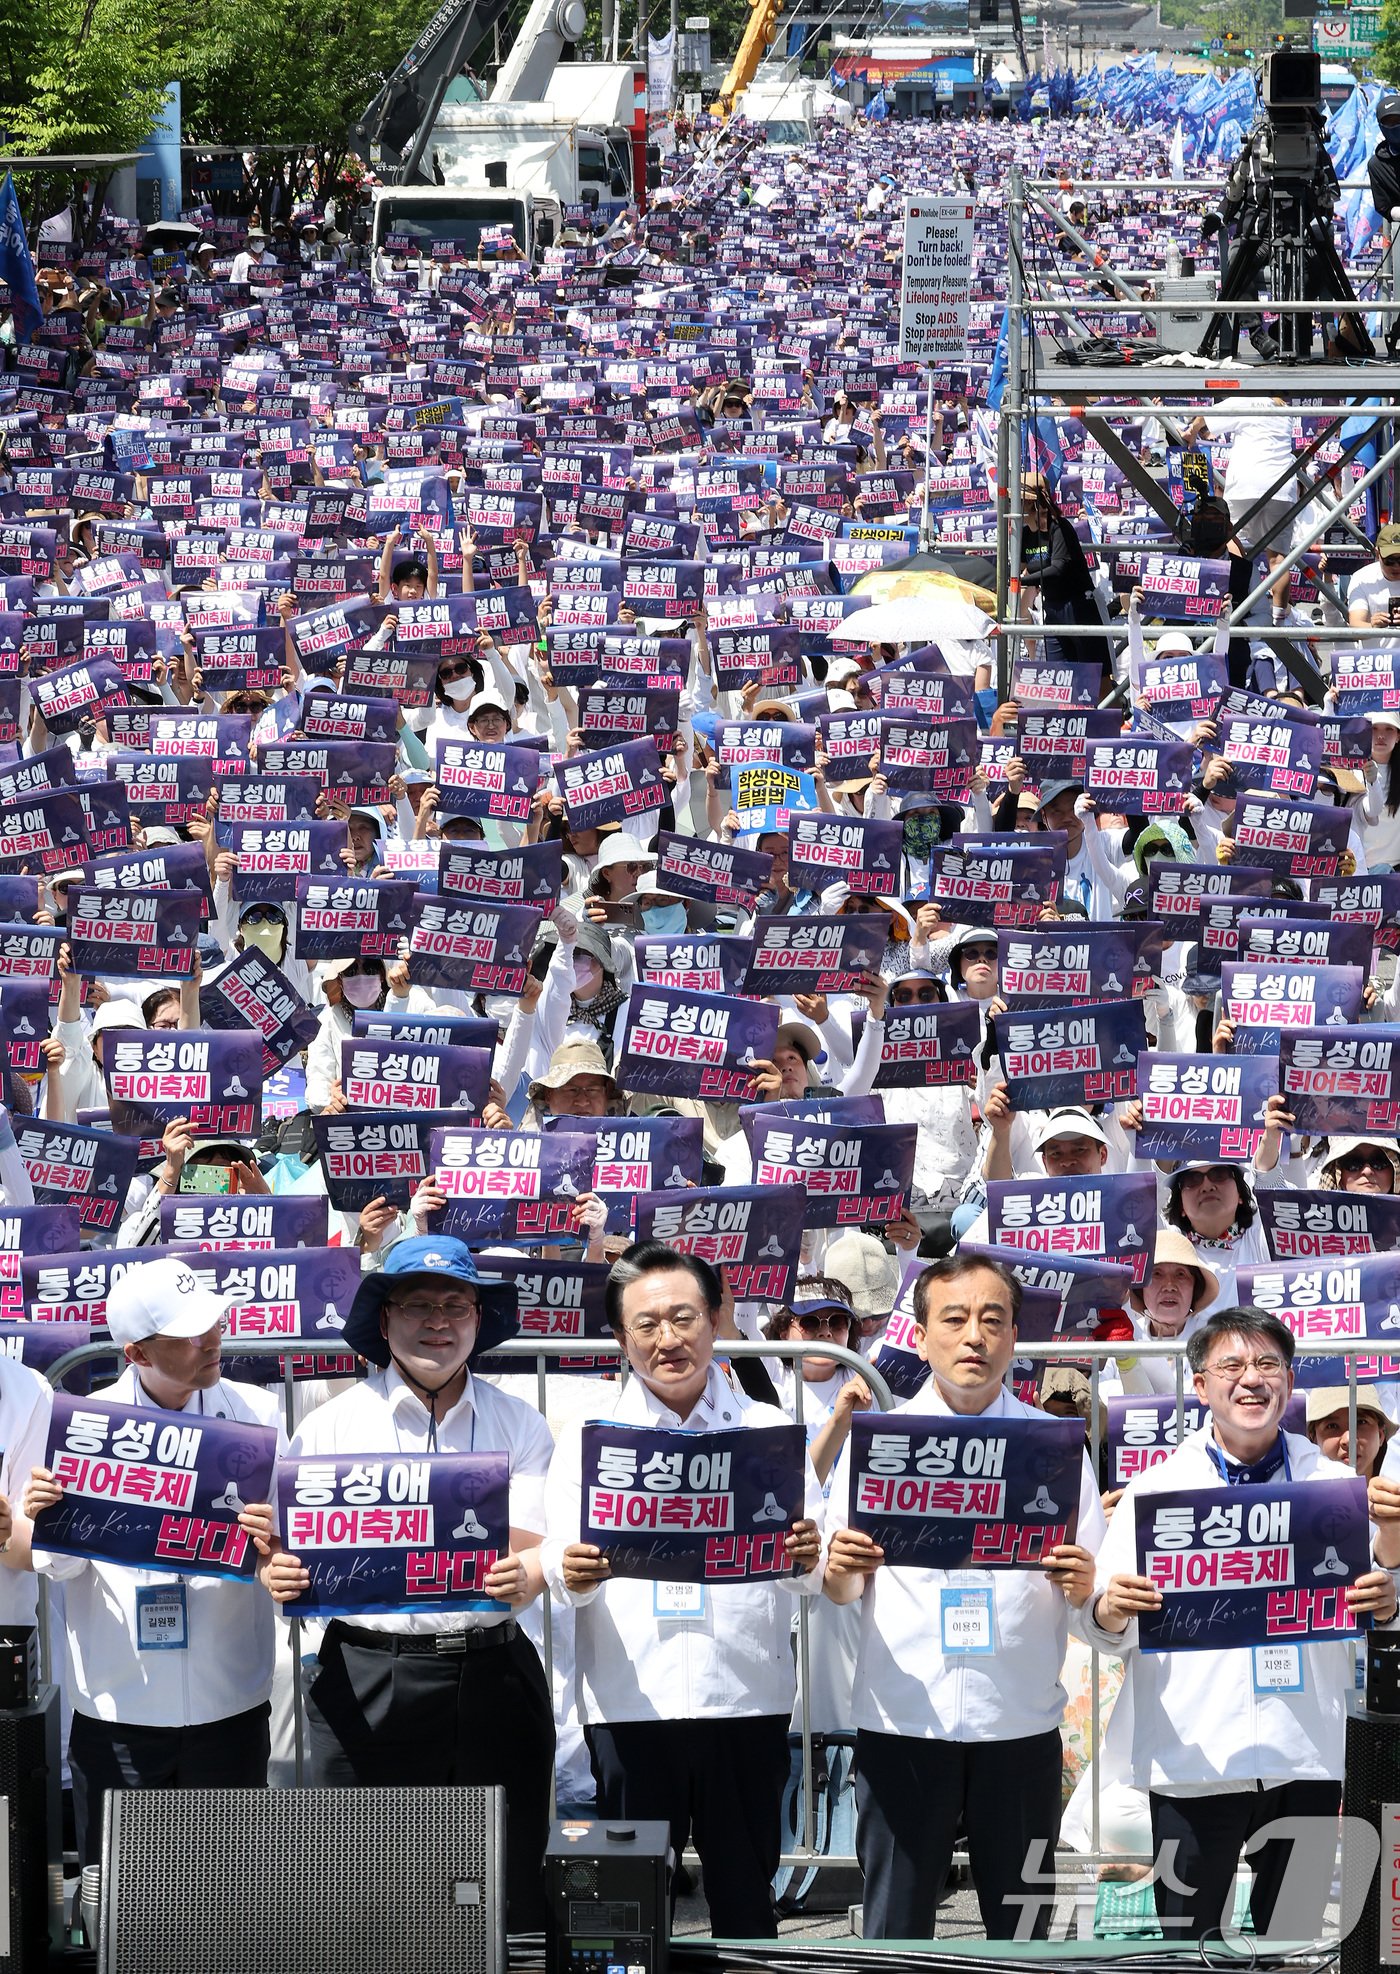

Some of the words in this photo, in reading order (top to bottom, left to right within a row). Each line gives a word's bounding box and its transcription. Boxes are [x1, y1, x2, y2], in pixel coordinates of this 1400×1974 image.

[920, 209, 938, 217] YouTube
[926, 226, 958, 239] Please!
[918, 240, 938, 252] Turn
[940, 240, 963, 252] back!
[907, 254, 930, 267] Don't
[932, 254, 942, 266] be
[944, 253, 970, 266] fooled!
[907, 275, 941, 290] Temporary
[943, 275, 968, 288] Pleasure,
[906, 291, 939, 306] Lifelong
[941, 291, 968, 305] Regret!
[915, 312, 936, 326] Stop
[938, 311, 958, 324] AIDS
[905, 326, 924, 340] Stop
[926, 325, 964, 340] paraphilia
[905, 341, 921, 355] They
[923, 343, 934, 352] are
[935, 340, 964, 352] treatable.
[544, 458, 581, 471] 동성애
[930, 465, 969, 478] 동성애
[77, 474, 115, 490] 동성애
[152, 480, 191, 493] 동성애
[542, 470, 581, 483] 퀴어축제
[698, 470, 738, 484] 동성애
[784, 470, 825, 483] 동성애
[929, 478, 970, 490] 퀴어축제
[72, 486, 112, 500] 퀴어축제
[151, 494, 190, 504] 퀴어축제
[374, 482, 420, 496] 동성애
[697, 485, 739, 497] 퀴어축제
[783, 484, 825, 495] 퀴어축제
[817, 494, 843, 506] 반대
[963, 490, 990, 502] 반대
[370, 497, 419, 512] 퀴어축제
[469, 494, 515, 510] 동성애
[732, 495, 759, 510] 반대
[410, 513, 442, 531] 반대
[468, 509, 514, 526] 퀴어축제
[230, 532, 275, 548] 동성애
[228, 547, 272, 560] 퀴어축제
[1146, 558, 1200, 578] 동성애
[1143, 577, 1197, 594] 퀴어축제
[1184, 597, 1221, 616] 반대
[296, 610, 346, 641] 동성애
[397, 623, 451, 639] 퀴어축제
[203, 636, 256, 651] 동성애
[605, 638, 659, 655] 동성애
[718, 636, 770, 654] 동성애
[202, 654, 256, 668] 퀴어축제
[602, 656, 657, 672] 퀴어축제
[38, 668, 90, 700] 동성애
[762, 666, 796, 684] 반대
[43, 685, 97, 715] 퀴어축제
[157, 720, 217, 738] 동성애
[584, 713, 645, 731] 퀴어축제
[888, 728, 948, 749] 동성애
[444, 746, 505, 772] 동성애
[884, 749, 948, 767] 퀴어축제
[1227, 742, 1289, 765] 퀴어축제
[441, 765, 504, 790] 퀴어축제
[565, 753, 625, 788] 동성애
[738, 769, 800, 792] 학생인권
[1091, 770, 1155, 787] 퀴어축제
[1271, 769, 1313, 795] 반대
[489, 794, 532, 818] 반대
[623, 785, 664, 814] 반대
[737, 788, 785, 809] 특별법
[241, 830, 310, 851] 동성애
[797, 820, 864, 847] 동성애
[1237, 827, 1310, 851] 퀴어축제
[240, 853, 308, 872] 퀴어축제
[1290, 855, 1339, 877] 반대
[237, 879, 265, 895] Holy
[446, 874, 521, 896] 퀴어축제
[848, 871, 894, 894] 반대
[77, 895, 157, 921] 동성애
[420, 904, 499, 937] 동성애
[413, 930, 492, 959] 퀴어축제
[764, 926, 845, 948] 동성애
[138, 948, 193, 974] 반대
[756, 949, 838, 969] 퀴어축제
[238, 959, 295, 1020] 동성애
[1231, 974, 1315, 1001] 동성애
[639, 998, 730, 1038] 동성애
[1230, 1002, 1312, 1026] 퀴어축제
[1008, 1017, 1096, 1051] 동성애
[1008, 1047, 1097, 1076] 퀴어축제
[1292, 1040, 1392, 1069] 동성애
[114, 1076, 207, 1099] 퀴어축제
[1149, 1064, 1241, 1094] 동성애
[1287, 1069, 1387, 1096] 퀴어축제
[327, 1123, 418, 1150] 동성애
[1143, 1129, 1181, 1155] Holy
[1181, 1127, 1215, 1145] Korea
[441, 1136, 541, 1167] 동성애
[330, 1153, 421, 1178] 퀴어축제
[836, 1194, 904, 1224] 반대
[1001, 1190, 1101, 1226] 동성애
[173, 1206, 273, 1237] 동성애
[437, 1206, 472, 1235] Holy
[652, 1201, 751, 1238] 동성애
[1251, 1269, 1361, 1306] 동성애
[66, 1410, 202, 1469] 동성애
[868, 1434, 1007, 1477] 동성애
[597, 1446, 731, 1490] 동성애
[58, 1456, 193, 1508] 퀴어축제
[295, 1463, 431, 1504] 동성애
[861, 1478, 1001, 1515] 퀴어축제
[593, 1493, 729, 1528] 퀴어축제
[46, 1508, 94, 1541] Holy
[97, 1512, 155, 1540] Korea
[292, 1509, 429, 1544] 퀴어축제
[1152, 1501, 1291, 1549] 동성애
[155, 1515, 249, 1567] 반대
[971, 1524, 1067, 1563] 반대
[705, 1530, 794, 1578] 반대
[347, 1557, 402, 1591] Korea
[405, 1550, 498, 1594] 반대
[1150, 1549, 1289, 1588] 퀴어축제
[1150, 1602, 1201, 1640] Holy
[1202, 1598, 1259, 1630] Korea
[1266, 1585, 1358, 1636] 반대
[148, 1617, 177, 1629] 길원평
[952, 1621, 981, 1633] 이용희
[156, 1634, 169, 1643] 교수
[1264, 1659, 1292, 1671] 지영준
